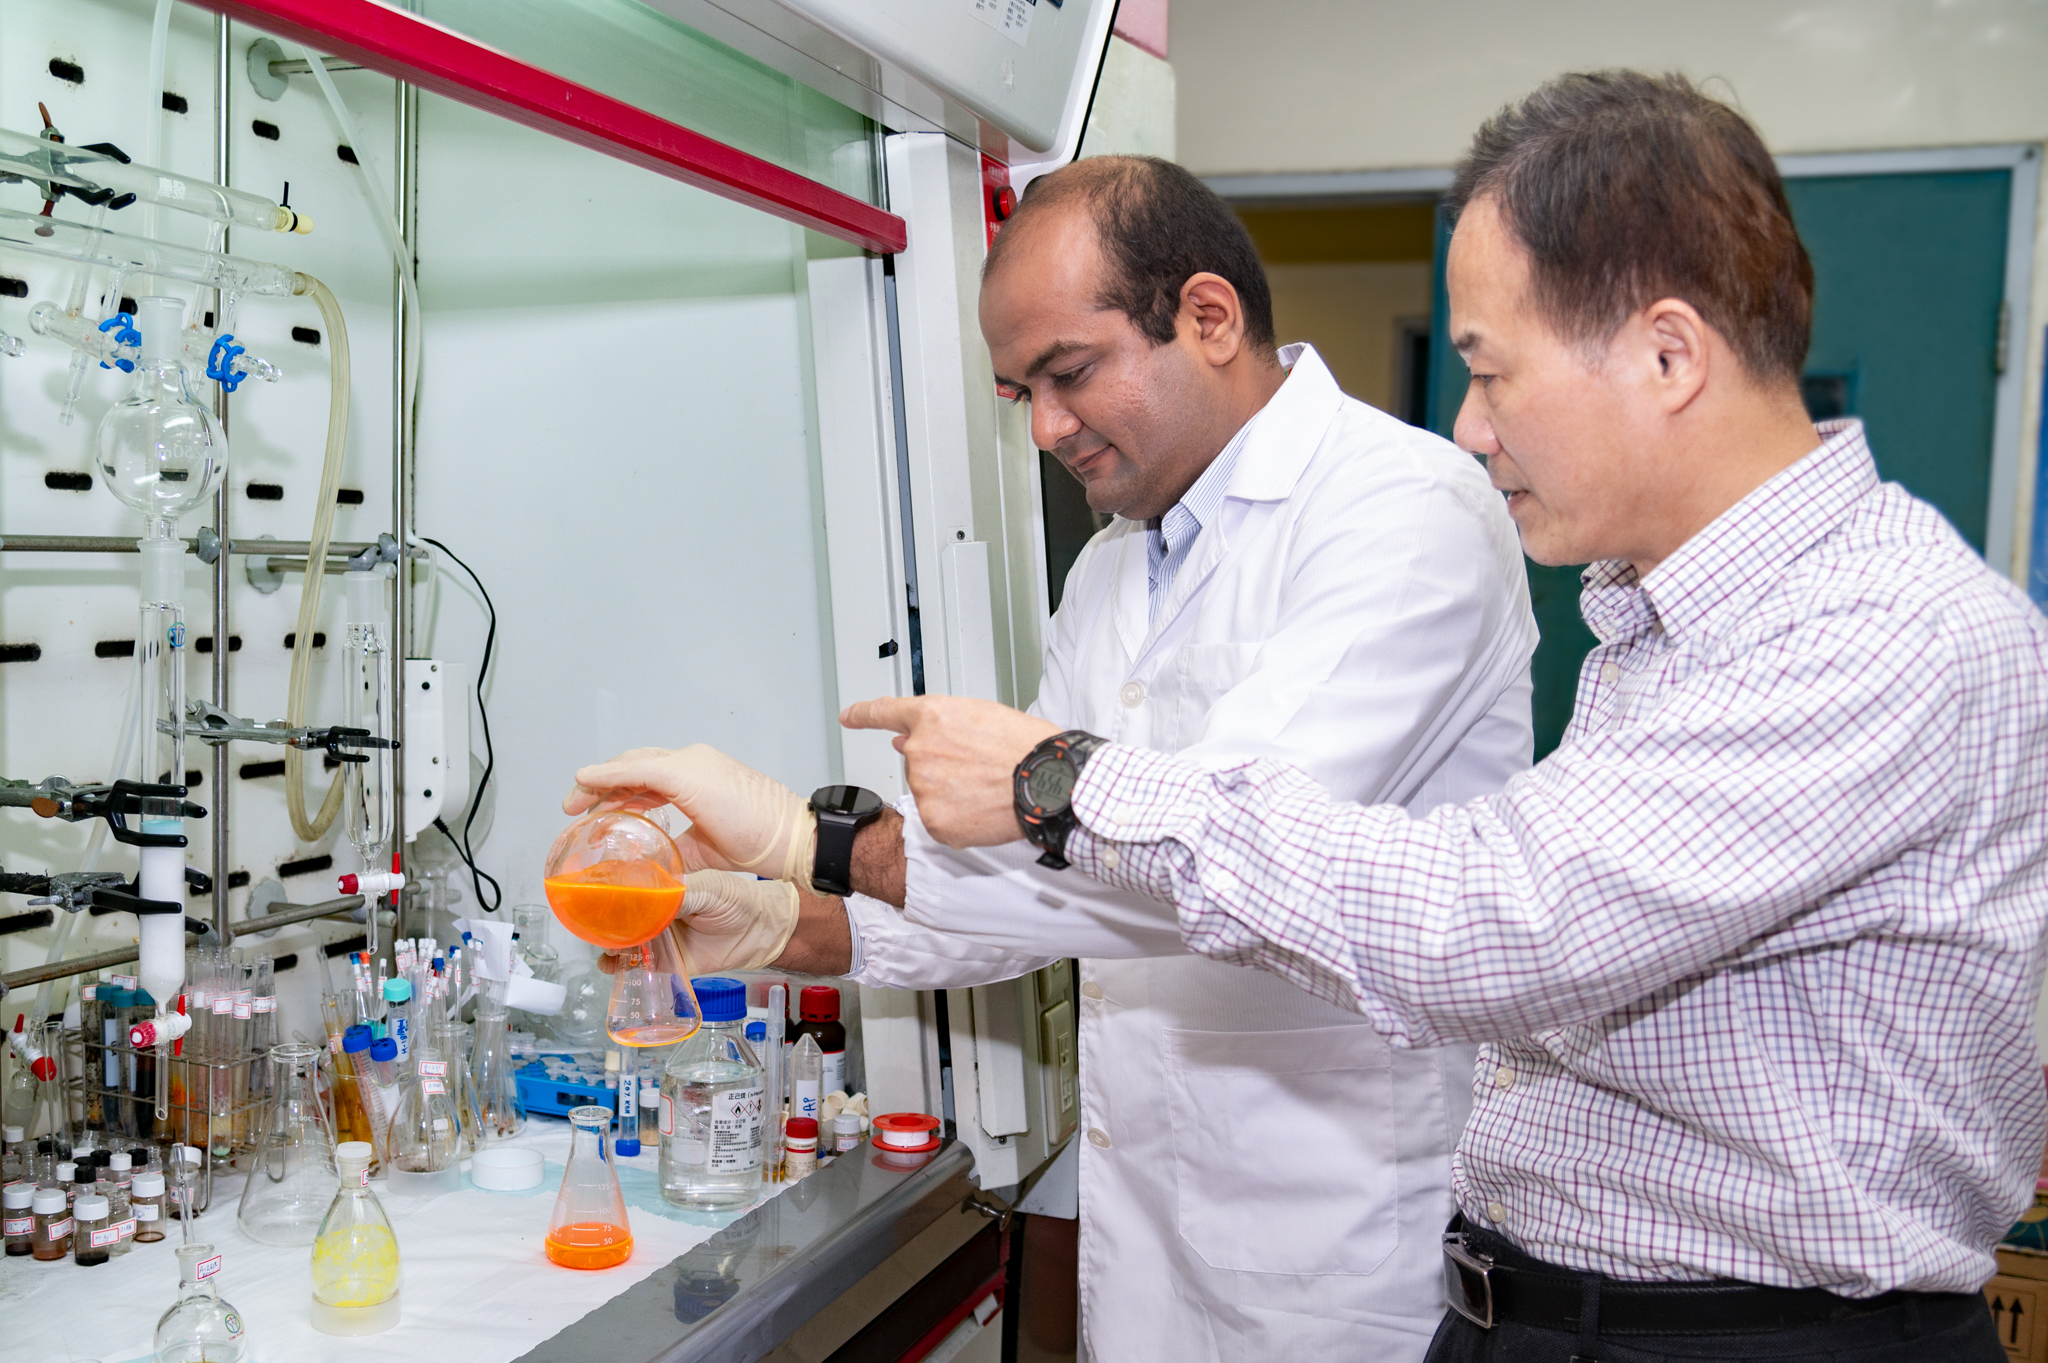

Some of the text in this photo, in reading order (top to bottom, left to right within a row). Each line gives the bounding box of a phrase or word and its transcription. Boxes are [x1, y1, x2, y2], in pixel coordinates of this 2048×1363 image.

[628, 979, 642, 987] 100
[631, 998, 641, 1006] 75
[598, 1183, 610, 1191] 125
[599, 1207, 611, 1215] 100
